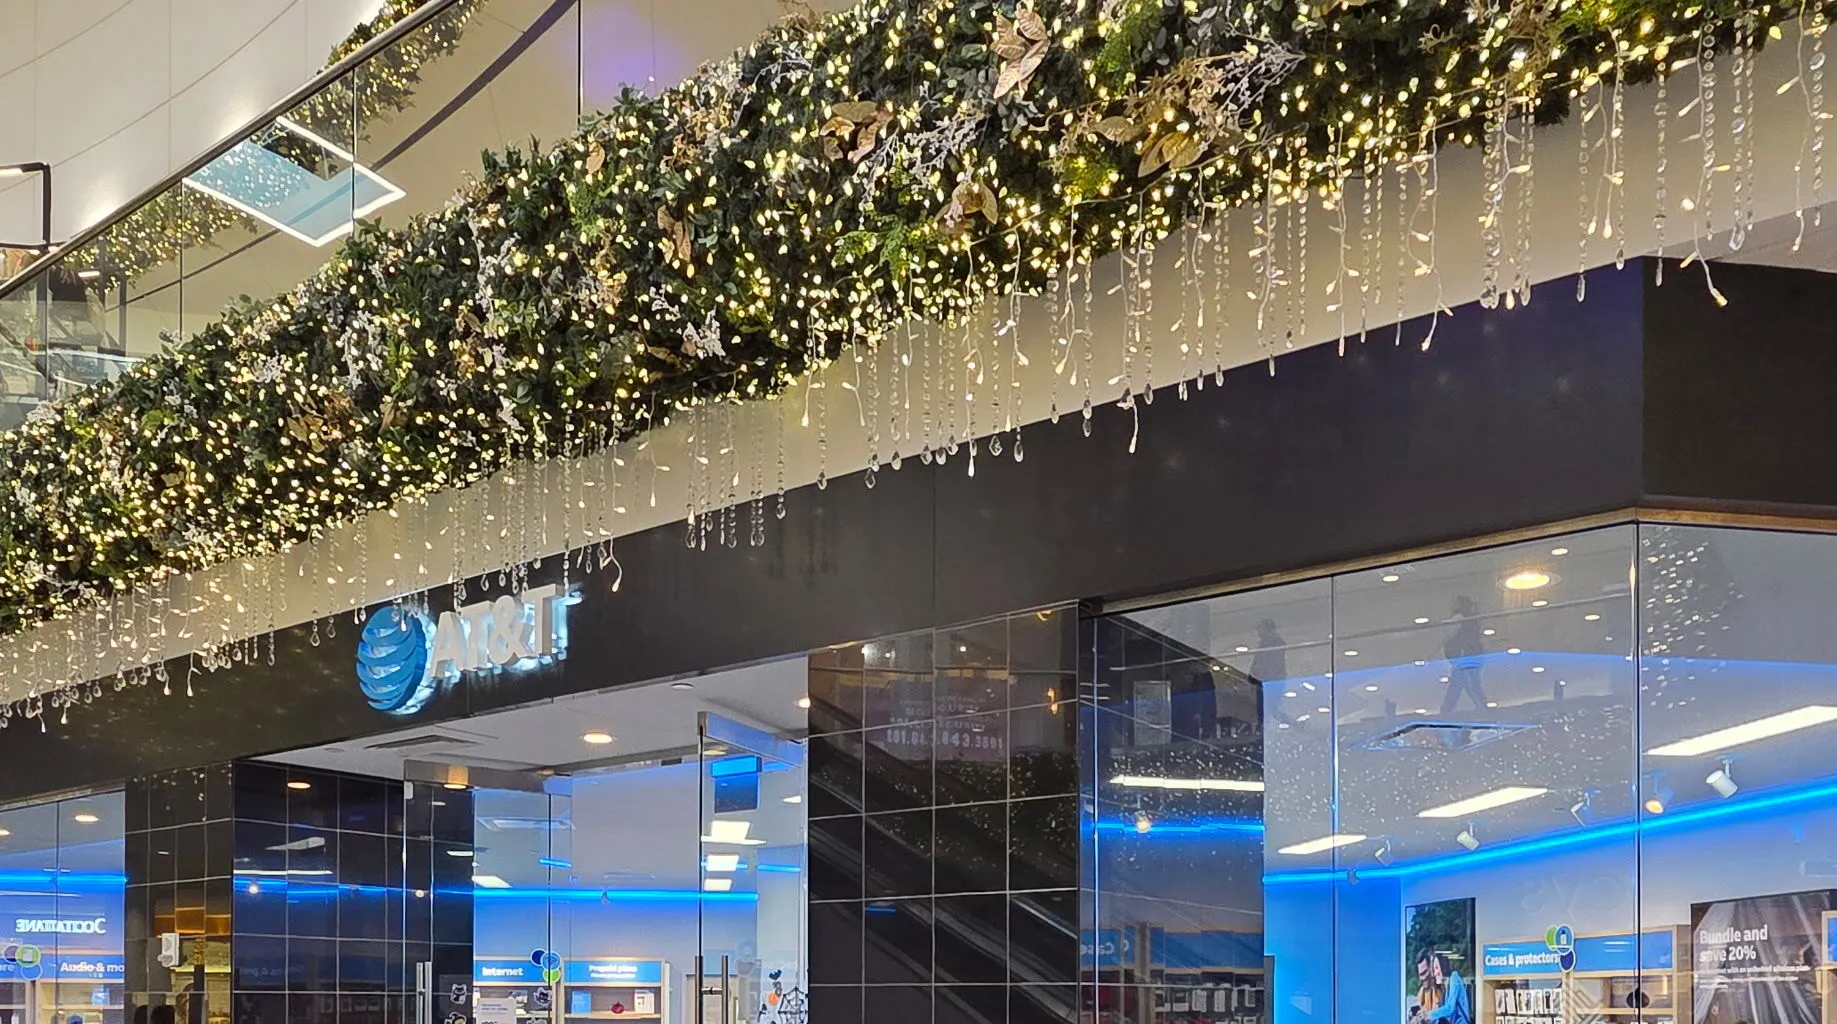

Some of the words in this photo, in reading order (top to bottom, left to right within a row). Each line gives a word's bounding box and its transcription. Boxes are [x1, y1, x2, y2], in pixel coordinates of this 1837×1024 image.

[428, 584, 562, 678] AT&T
[1699, 927, 1742, 944] Bundle
[1743, 924, 1768, 941] and
[1485, 953, 1508, 967] Cases
[1508, 953, 1515, 966] &
[1699, 950, 1727, 962] save
[1728, 945, 1757, 961] 20%
[60, 962, 94, 973] Audio
[96, 962, 105, 973] &
[481, 966, 524, 977] Internet
